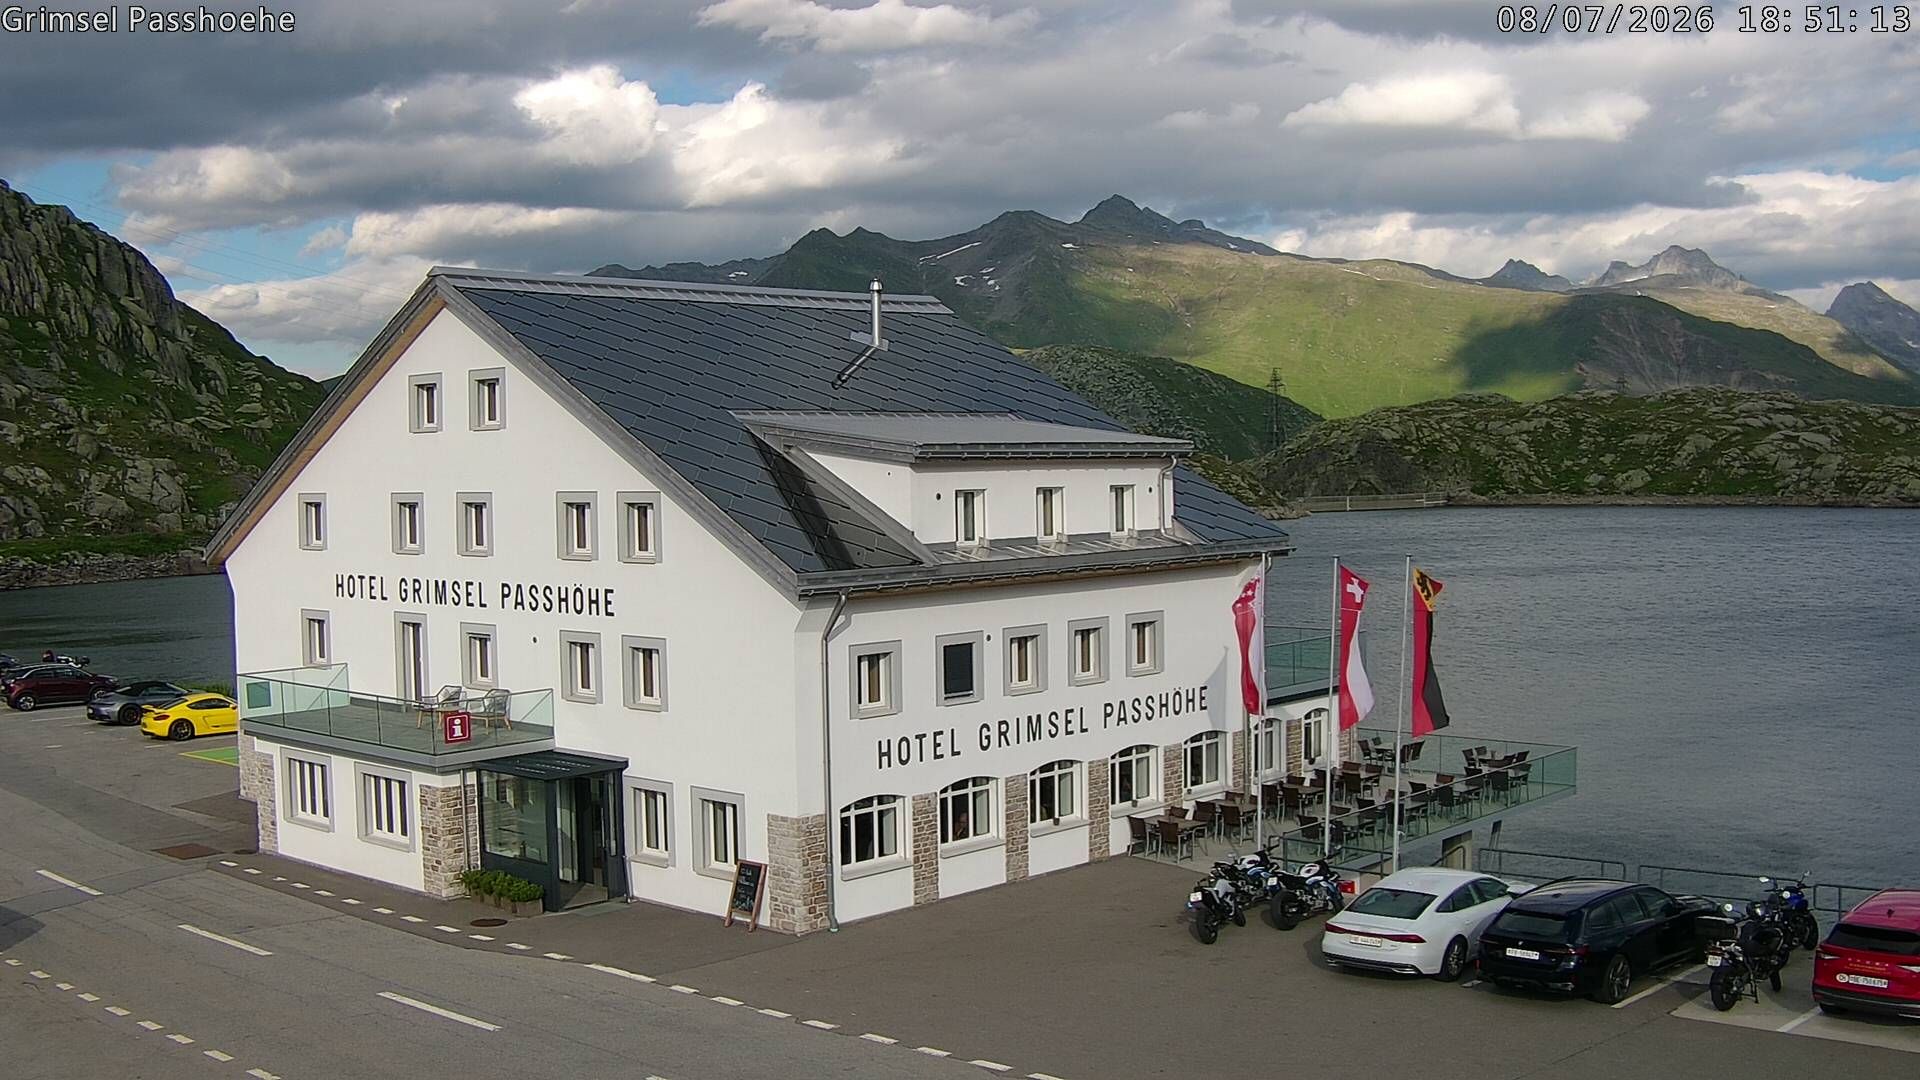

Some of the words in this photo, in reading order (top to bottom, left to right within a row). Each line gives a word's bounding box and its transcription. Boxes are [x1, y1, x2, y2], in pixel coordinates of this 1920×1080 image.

[335, 573, 388, 601] HOTEL
[399, 577, 487, 608] GRIMSEL
[500, 582, 616, 617] PASSHÖHE
[878, 728, 962, 769] HOTEL
[979, 706, 1089, 752] GRIMSEL
[1103, 685, 1208, 729] PASSHÖHE
